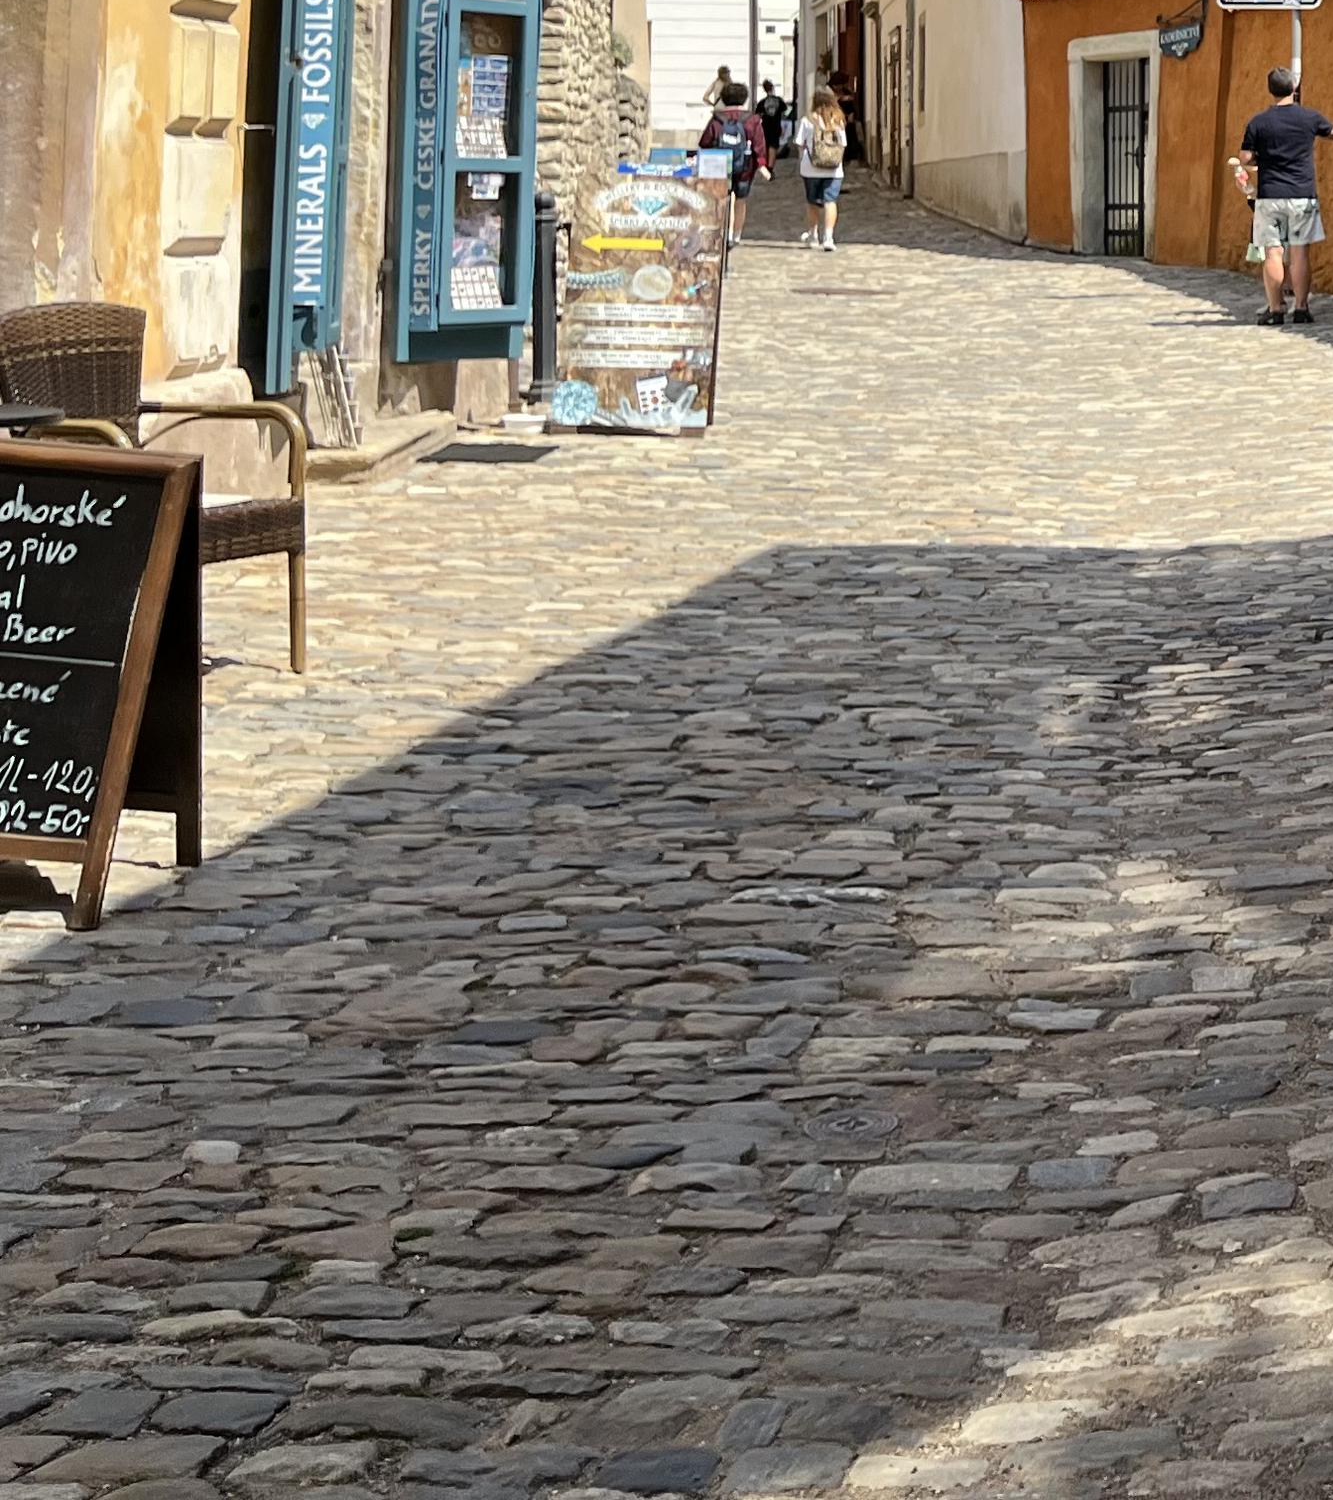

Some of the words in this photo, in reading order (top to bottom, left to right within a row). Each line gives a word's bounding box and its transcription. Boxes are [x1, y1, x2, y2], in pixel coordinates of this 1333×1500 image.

[413, 116, 436, 191] ČESKÉ
[292, 143, 328, 293] MINERALS
[409, 229, 432, 317] ŠPERKY
[3, 613, 76, 644] Beer
